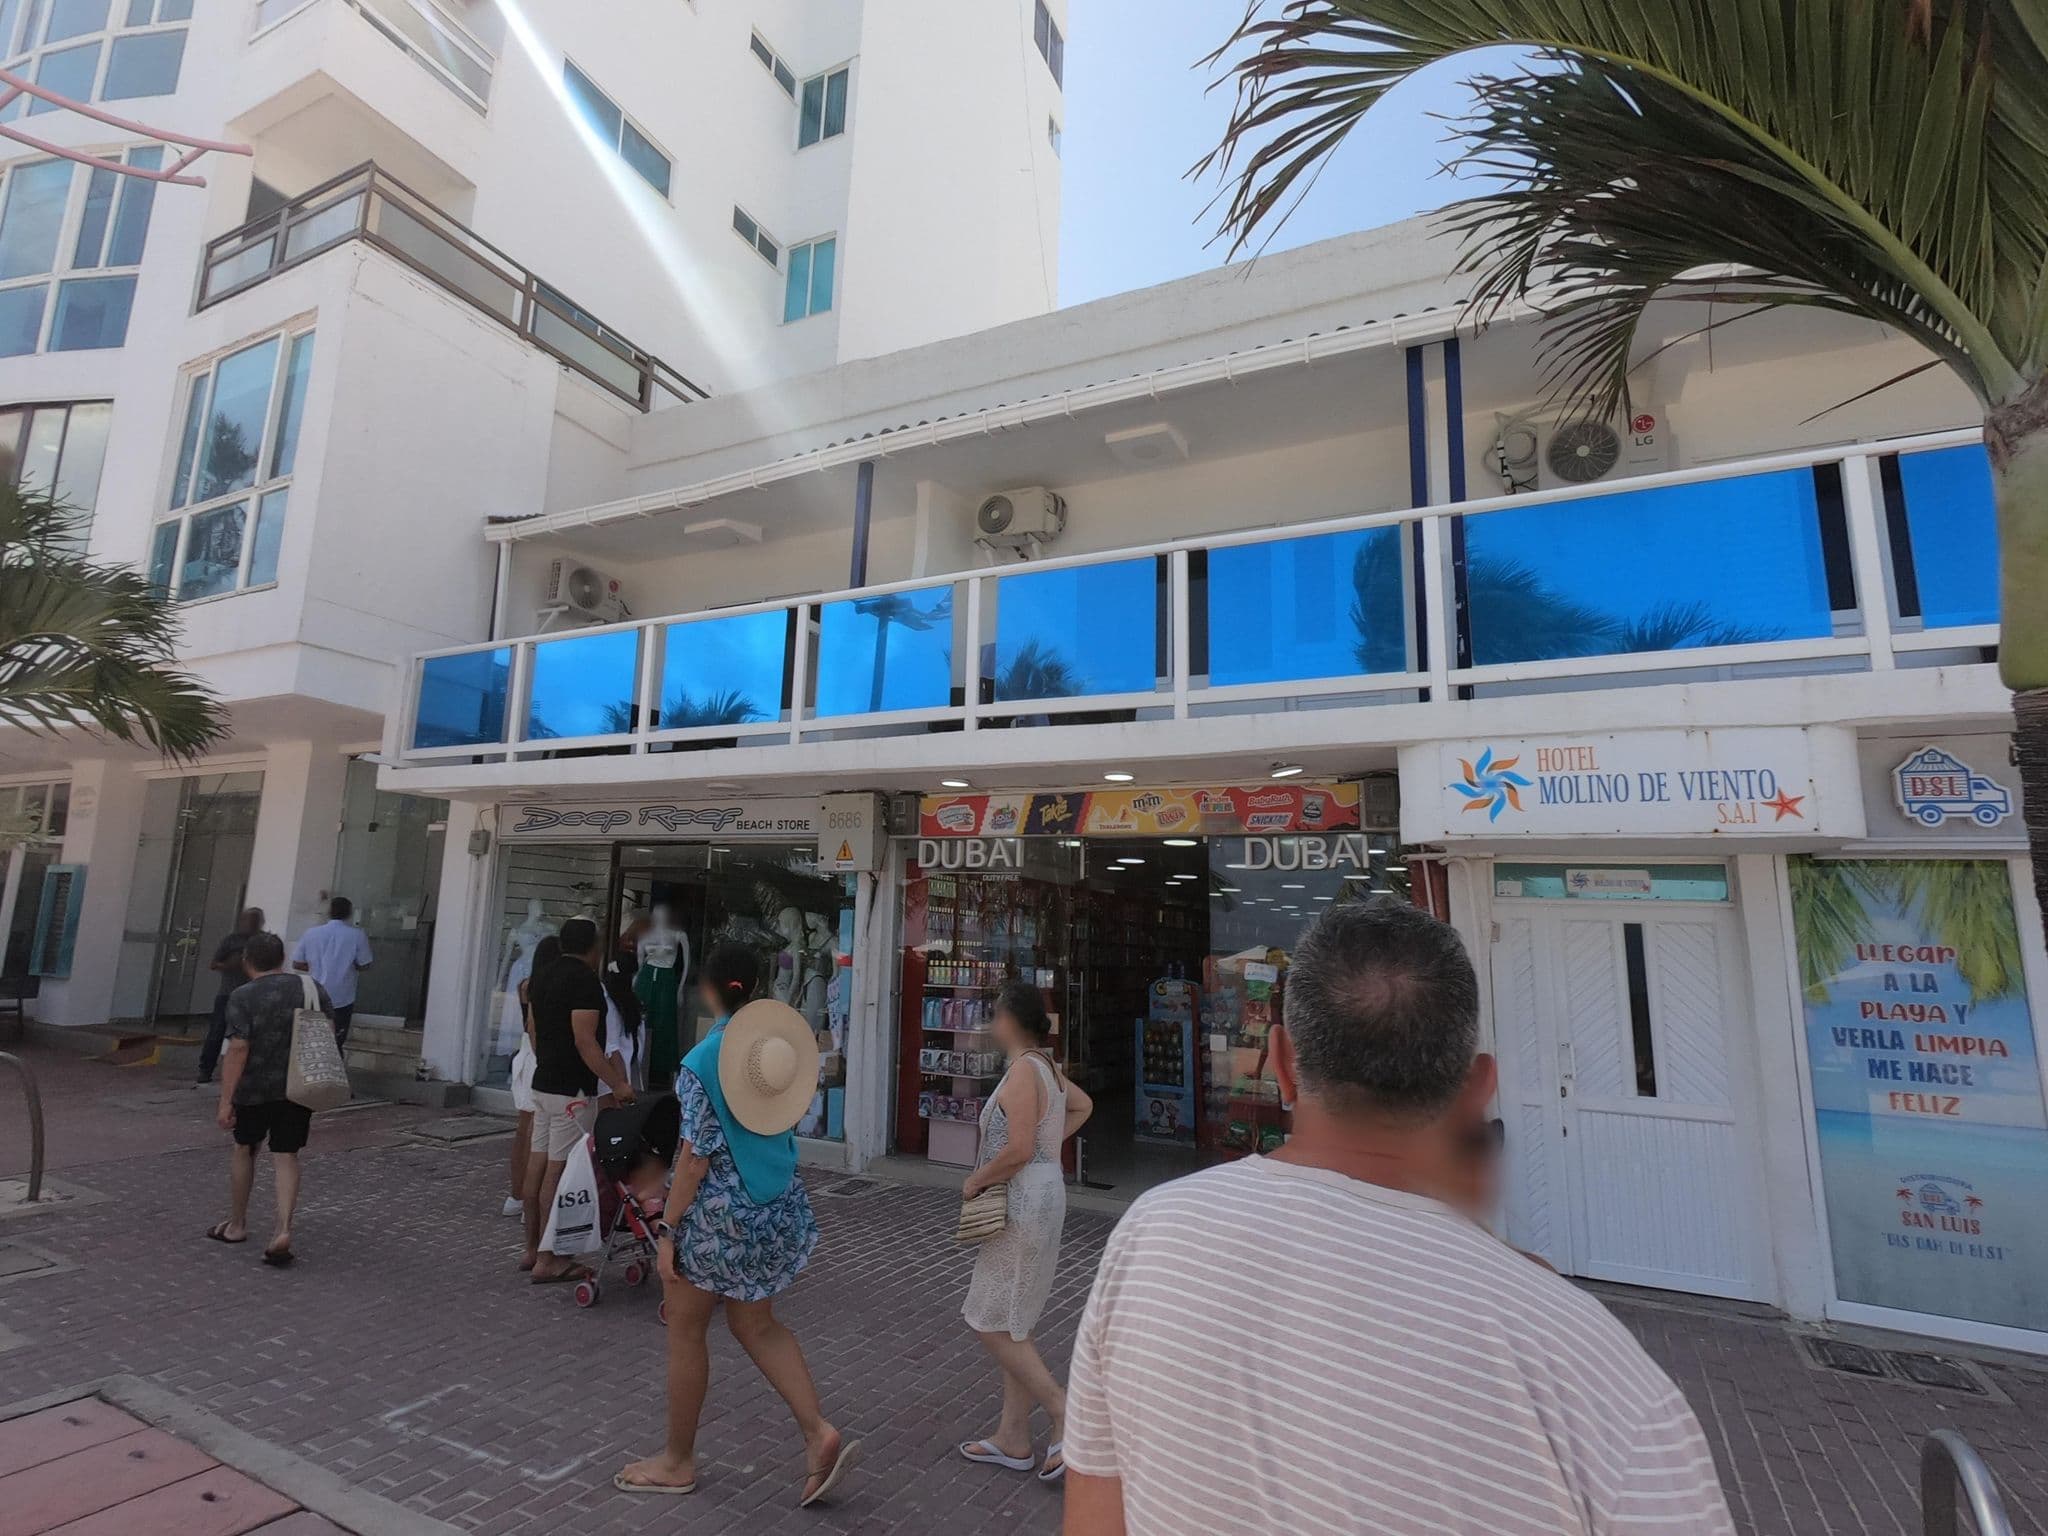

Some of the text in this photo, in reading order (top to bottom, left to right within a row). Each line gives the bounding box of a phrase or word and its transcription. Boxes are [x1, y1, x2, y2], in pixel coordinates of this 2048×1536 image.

[1635, 435, 1654, 447] LG
[1537, 746, 1599, 772] HOTEL
[1538, 768, 1776, 805] MOLINO DE VIENTO
[1910, 776, 1963, 797] DSL
[513, 805, 744, 833] Deep Reef
[736, 820, 811, 831] BEACH STORE
[917, 838, 1025, 869] DUBAI
[1244, 834, 1371, 871] DUBAI
[1884, 973, 1939, 993] A LA
[1952, 1004, 1969, 1025] Y
[1832, 1026, 2009, 1058] VERLA LIMPIA
[1867, 1058, 1974, 1086] ME HACE
[1888, 1091, 1961, 1116] FELIZ
[1902, 1210, 1981, 1235] SAN LUIS
